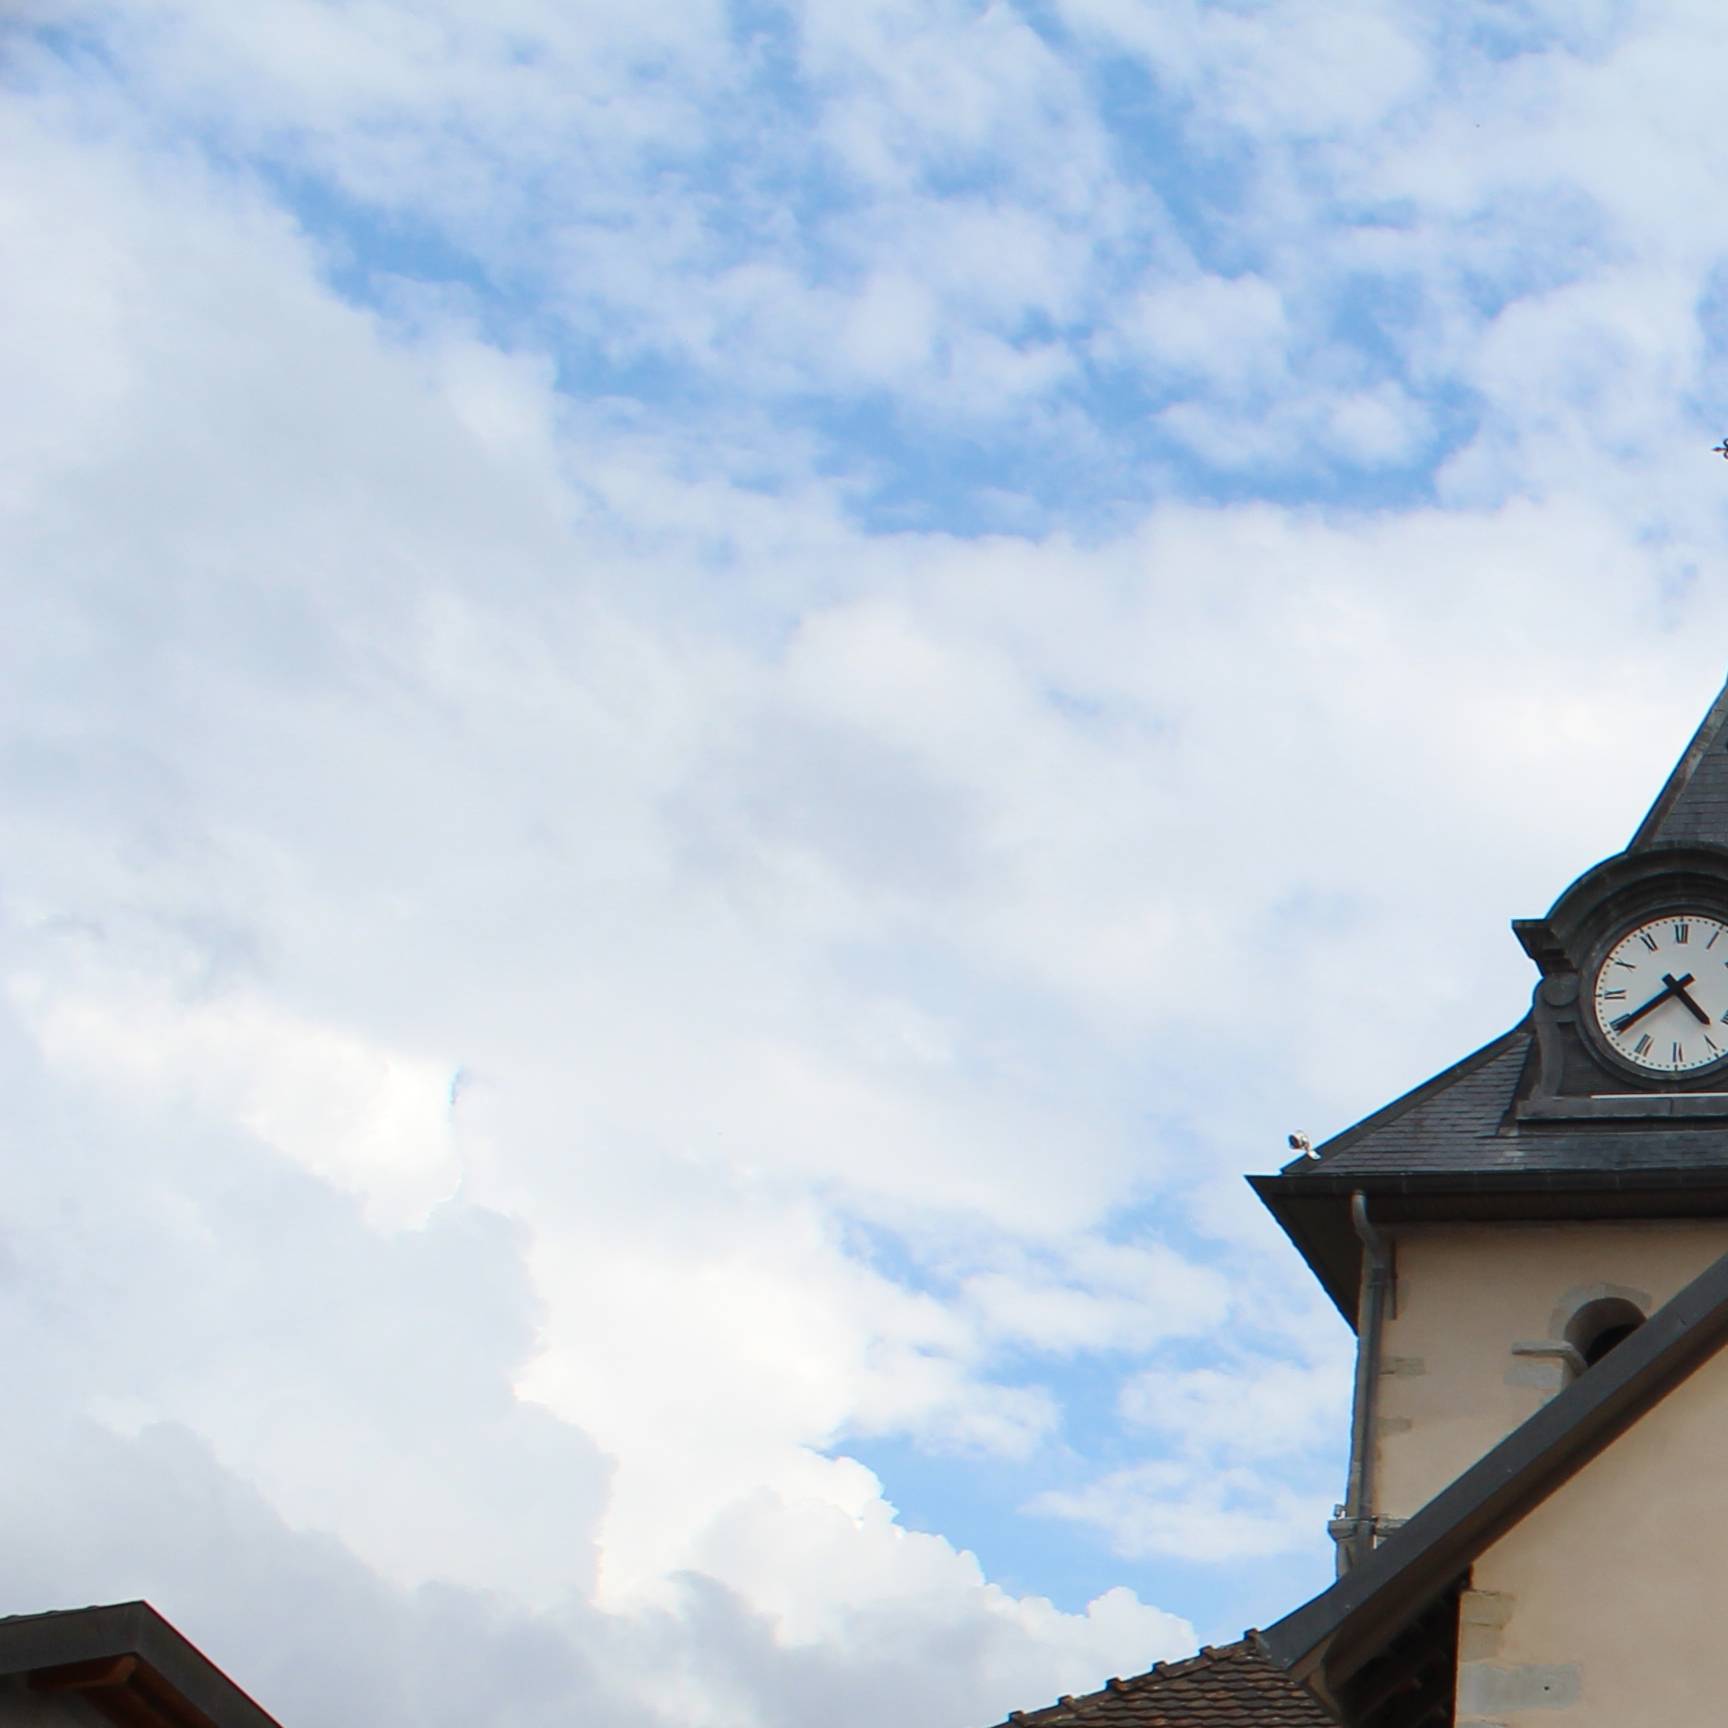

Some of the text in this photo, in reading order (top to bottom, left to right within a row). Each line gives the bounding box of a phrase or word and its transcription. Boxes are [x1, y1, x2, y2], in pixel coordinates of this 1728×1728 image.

[1640, 933, 1658, 951] XI
[1675, 924, 1689, 944] XII
[1706, 931, 1720, 950] I
